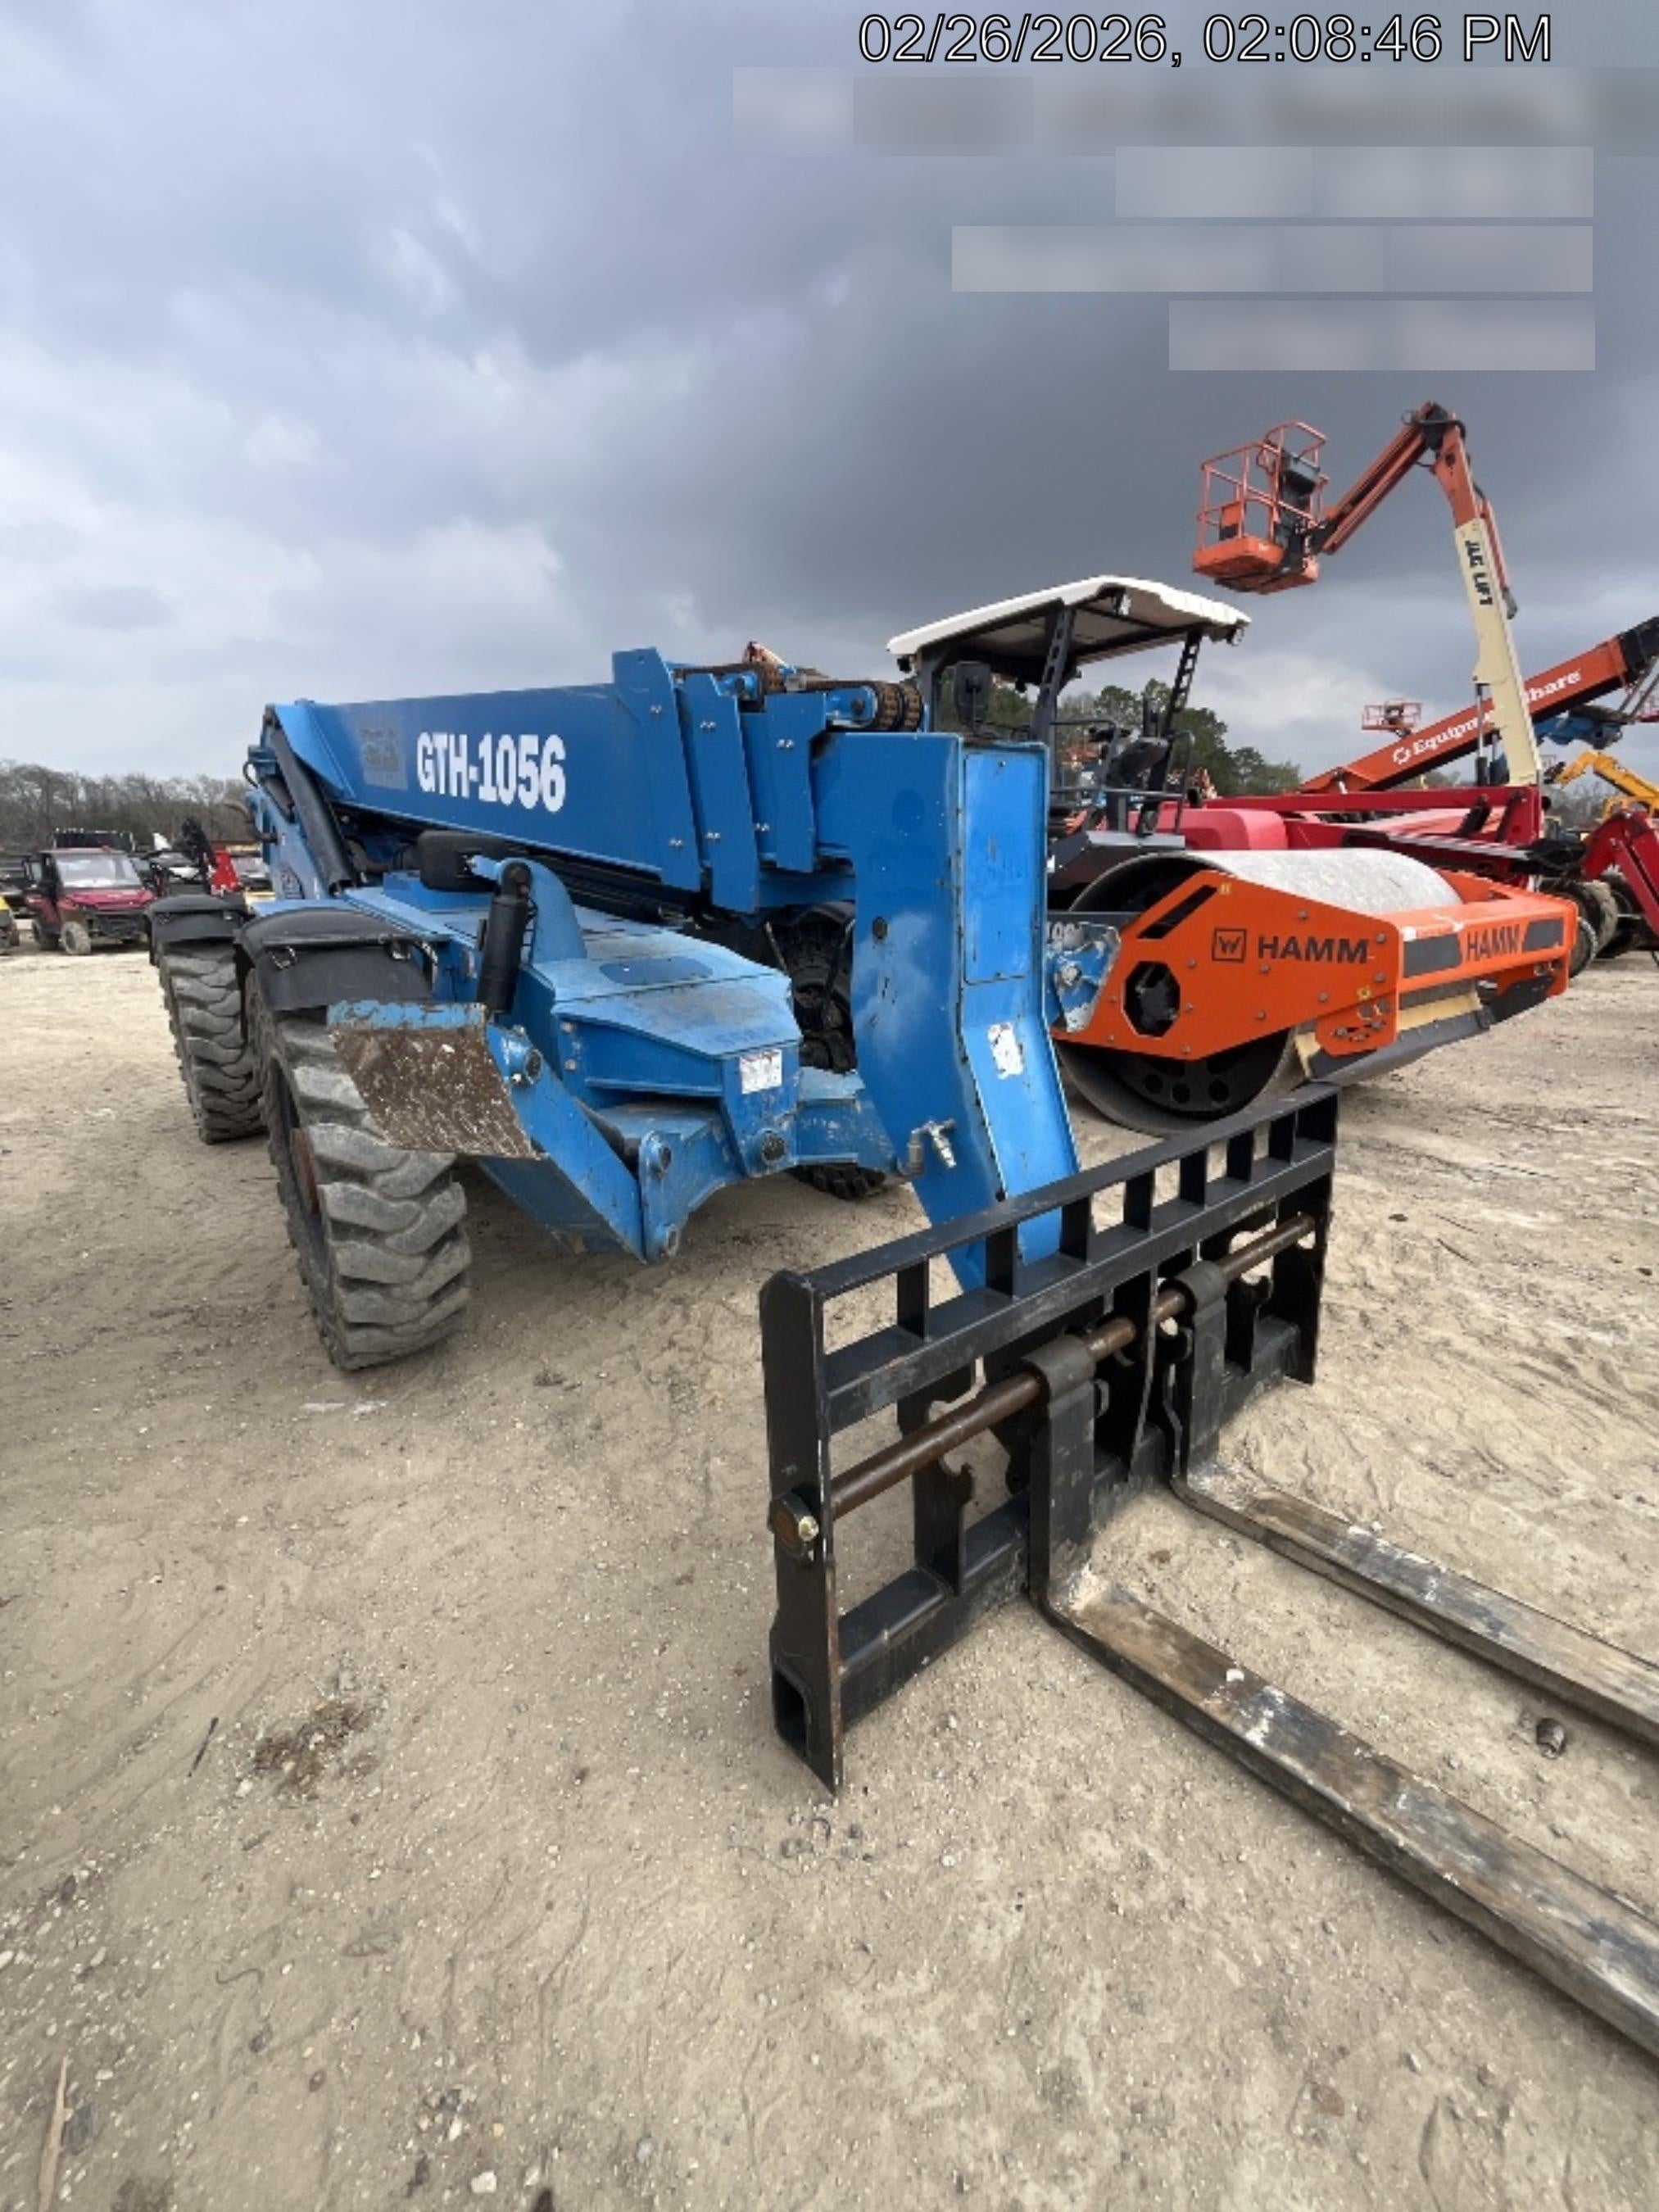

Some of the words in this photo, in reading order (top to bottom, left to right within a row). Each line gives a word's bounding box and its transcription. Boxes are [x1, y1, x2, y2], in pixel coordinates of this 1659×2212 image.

[417, 732, 566, 813] GTH-1056
[1258, 936, 1369, 963] HAMM
[1467, 924, 1520, 962] HAMM
